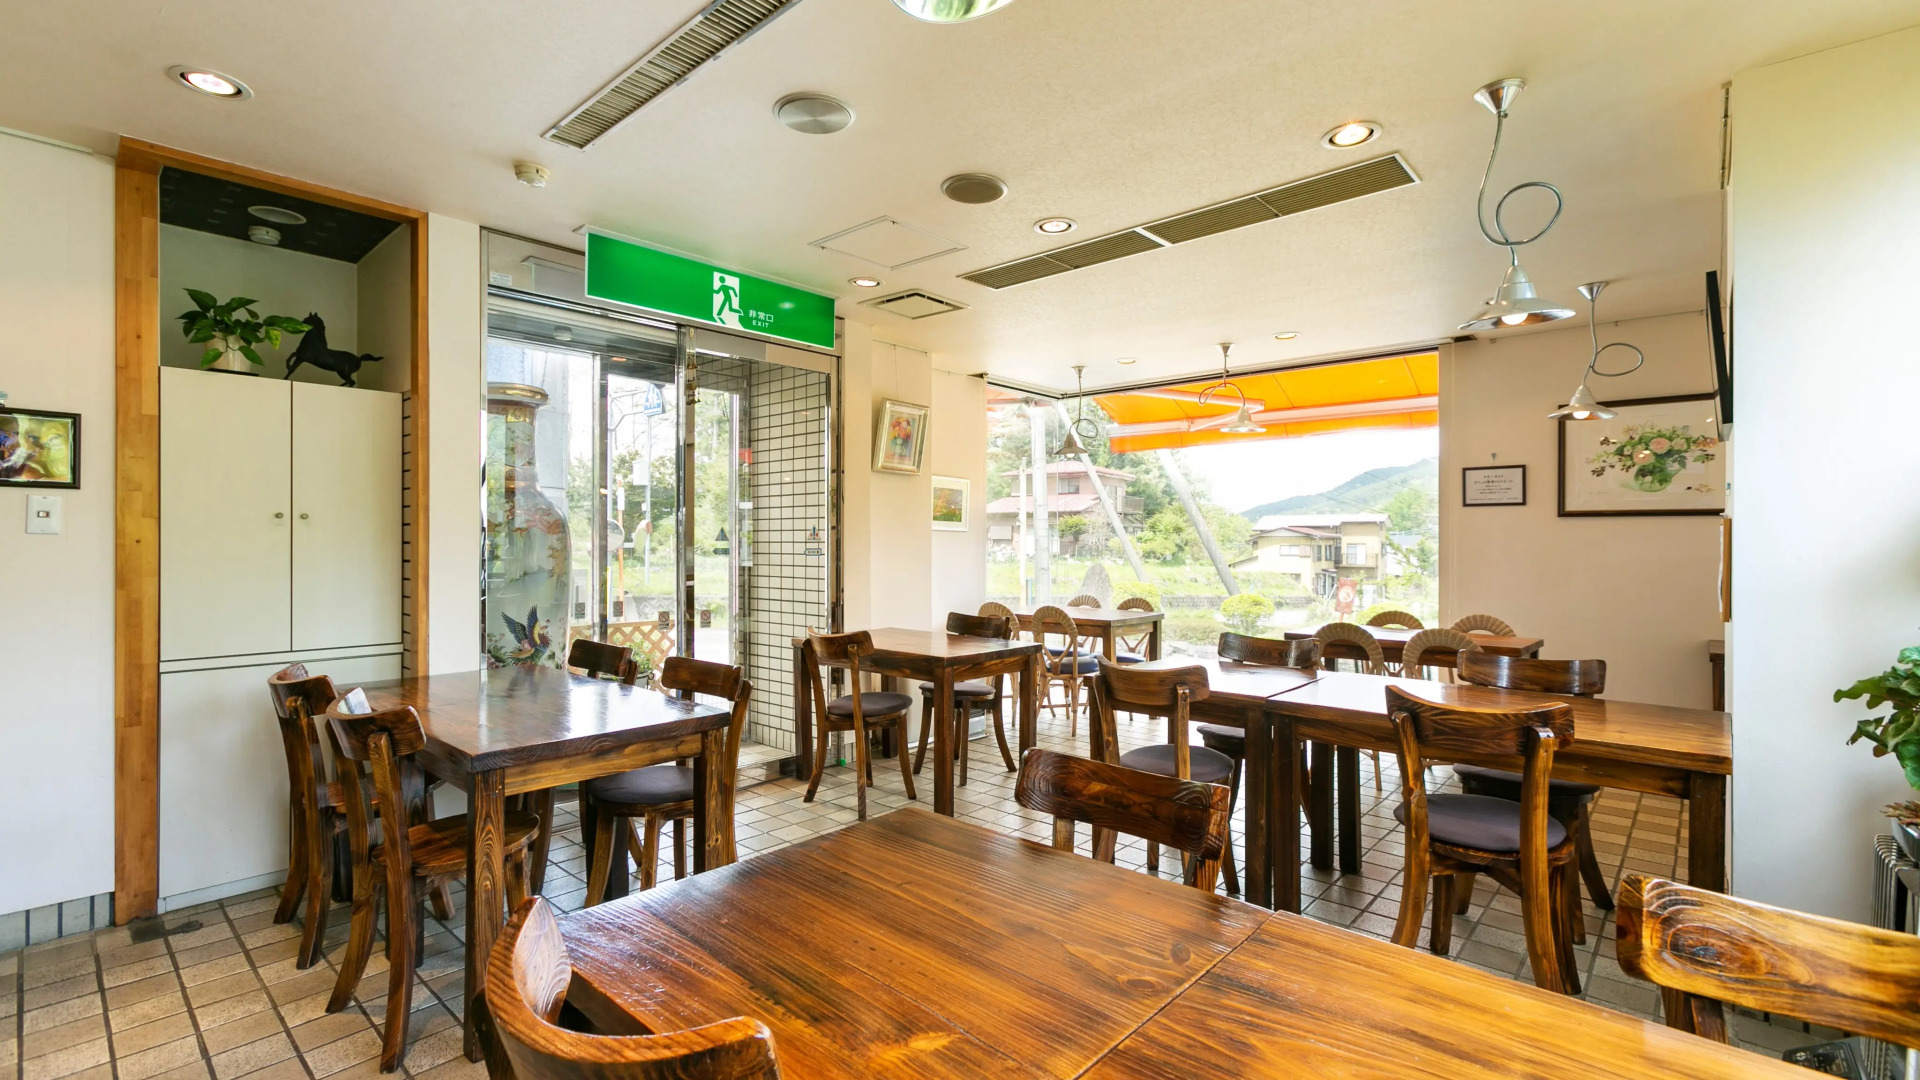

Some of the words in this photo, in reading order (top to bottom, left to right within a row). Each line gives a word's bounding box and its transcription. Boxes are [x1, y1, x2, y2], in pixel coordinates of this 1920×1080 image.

[749, 310, 774, 322] 非常口
[752, 320, 769, 328] EXIT
